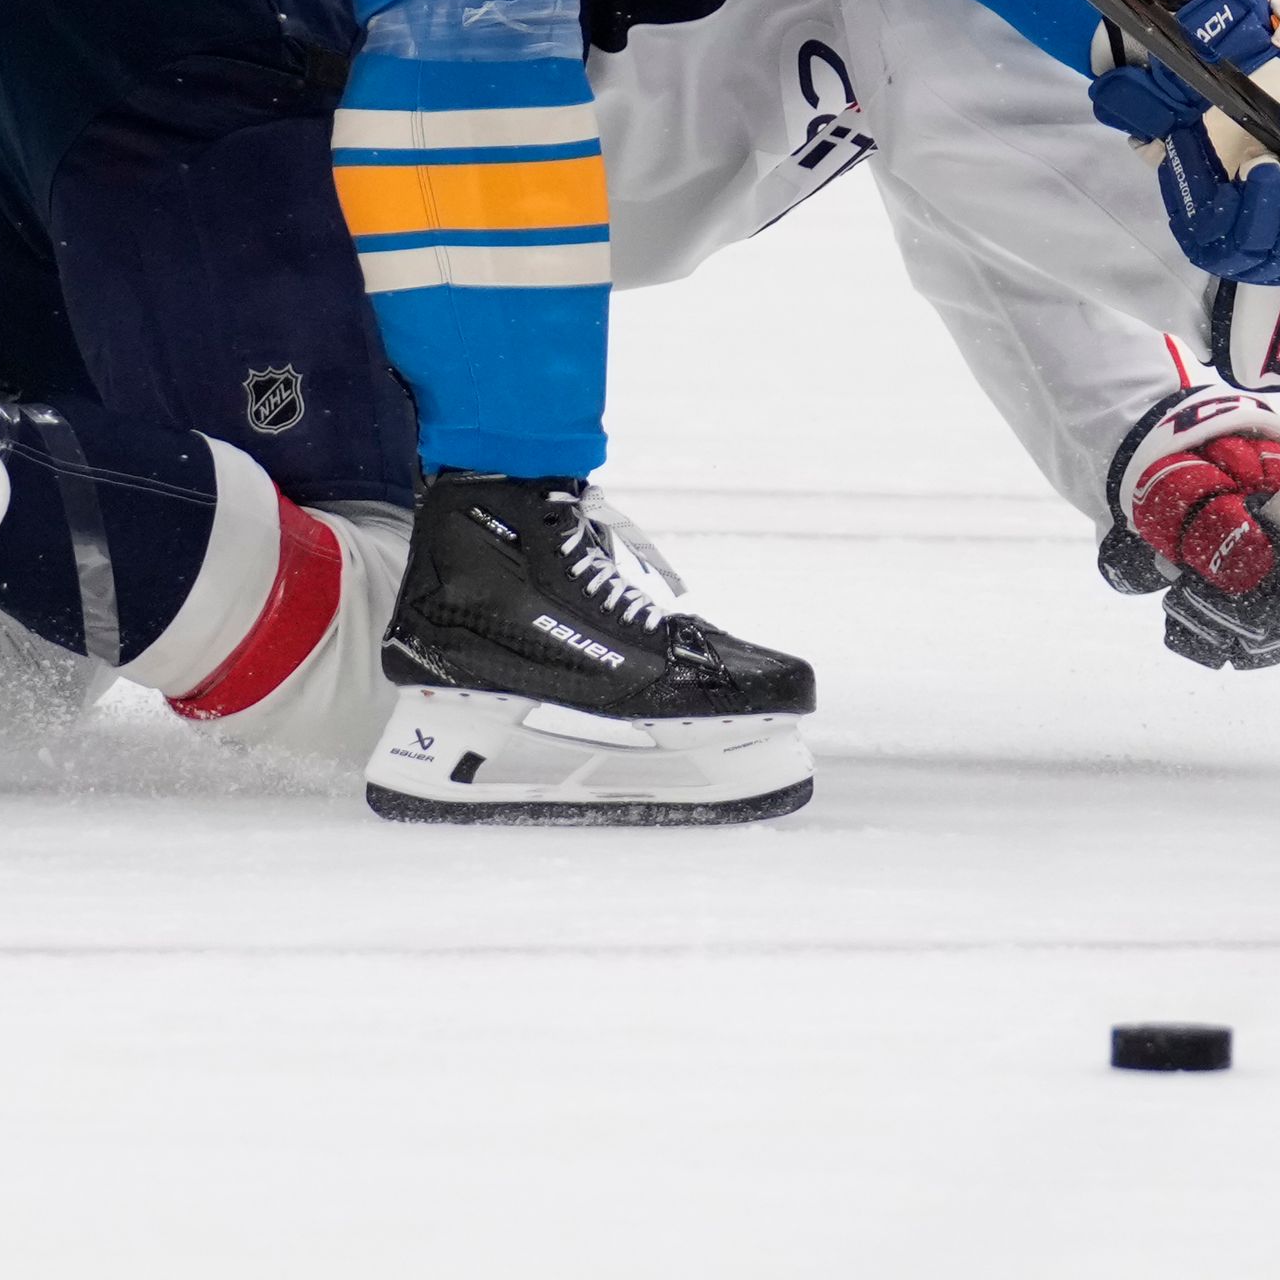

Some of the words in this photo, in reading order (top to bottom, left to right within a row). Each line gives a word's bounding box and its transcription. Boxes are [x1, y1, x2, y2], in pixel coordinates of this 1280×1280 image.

[259, 382, 292, 422] NHL
[1208, 520, 1250, 574] CCM
[531, 614, 626, 669] BAUER
